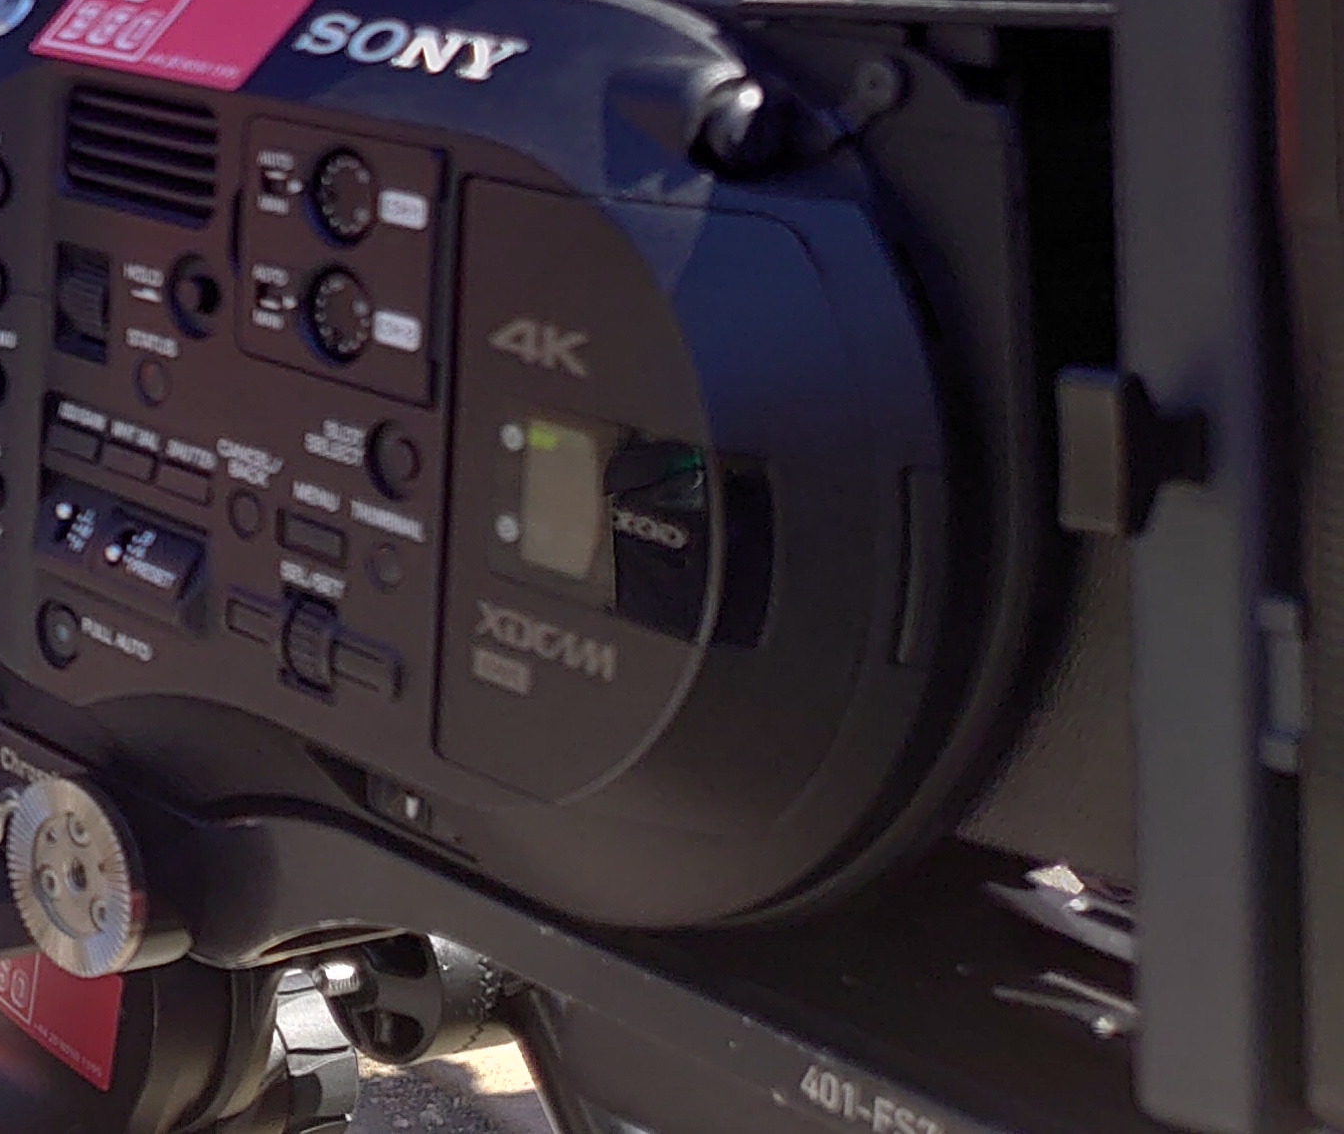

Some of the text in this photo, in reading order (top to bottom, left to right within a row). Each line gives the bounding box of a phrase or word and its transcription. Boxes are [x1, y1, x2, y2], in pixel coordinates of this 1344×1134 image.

[293, 10, 529, 80] SONY
[488, 317, 590, 378] 4K
[114, 631, 154, 663] AUTO
